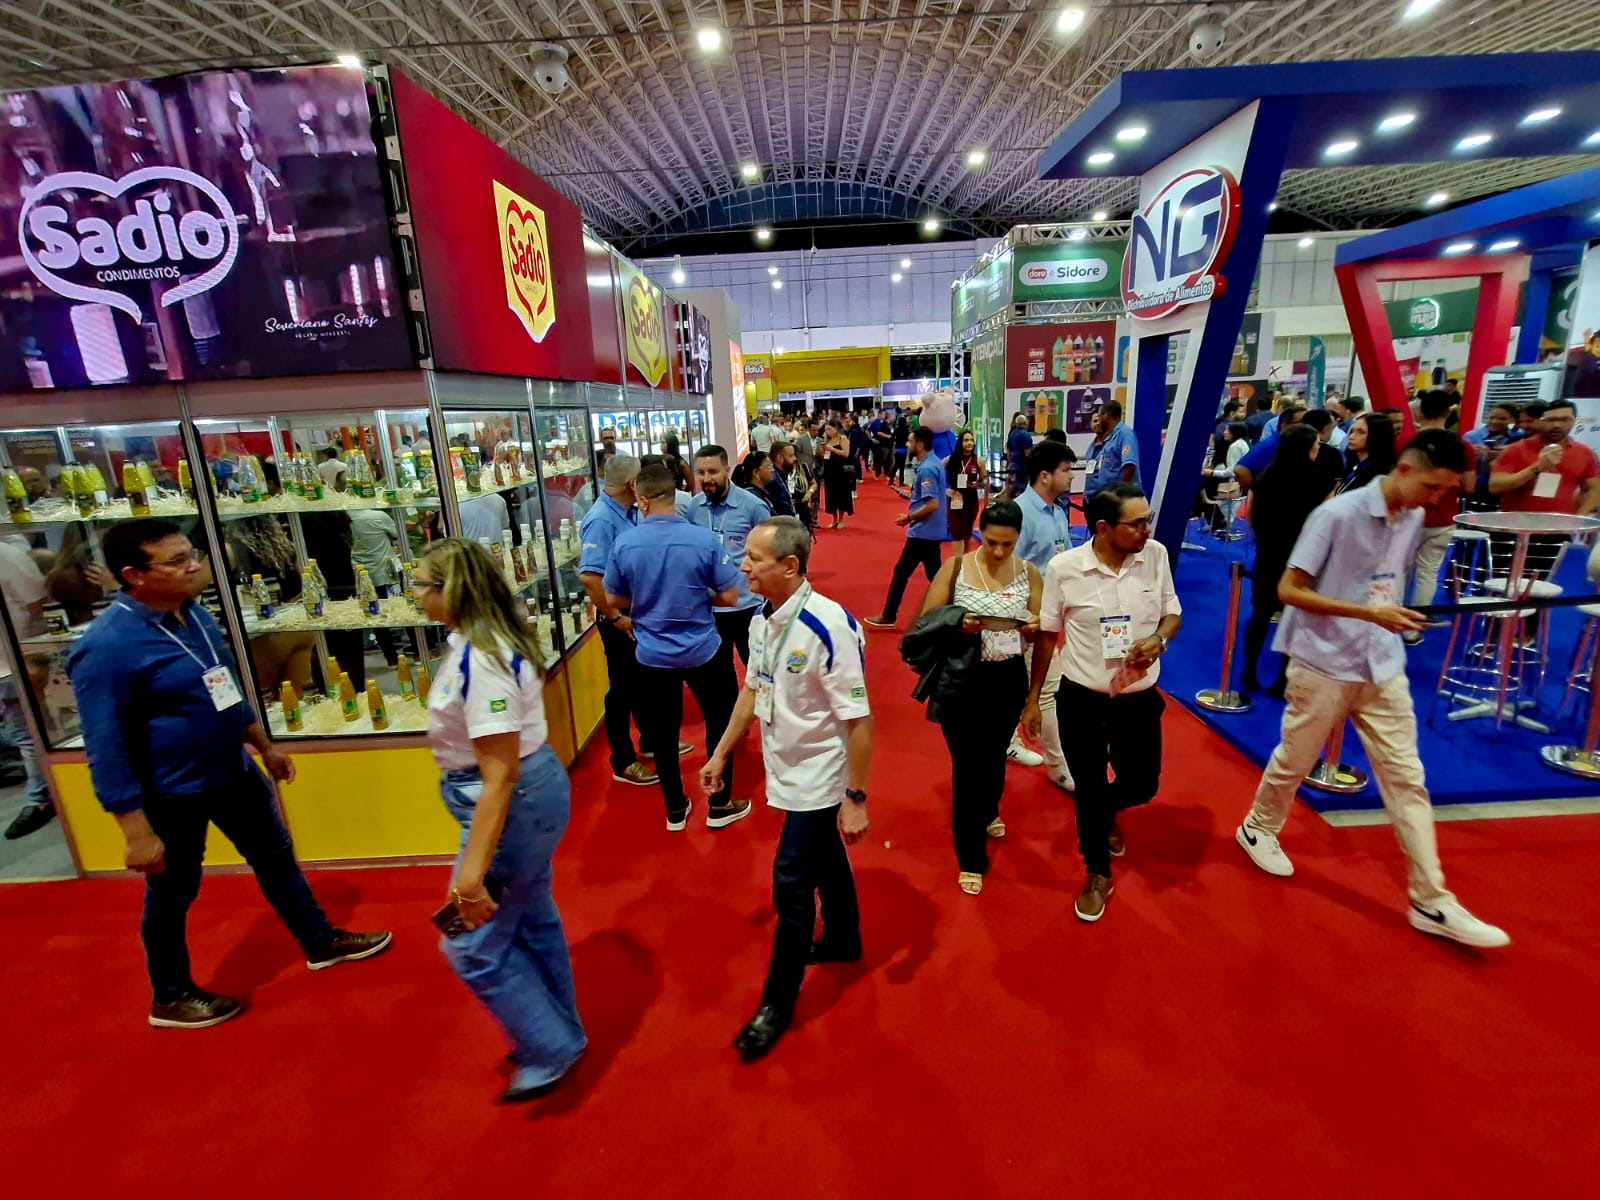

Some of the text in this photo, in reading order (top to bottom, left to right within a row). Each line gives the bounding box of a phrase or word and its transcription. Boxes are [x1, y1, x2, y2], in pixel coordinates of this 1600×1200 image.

[30, 199, 225, 269] Sadio
[1129, 174, 1223, 290] NG
[97, 266, 181, 283] CONDIMENTOS
[509, 223, 545, 286] Sadio
[1057, 265, 1100, 278] Sidore
[1127, 280, 1212, 311] Distribuidora de Alimentos
[631, 295, 659, 344] Sadio
[972, 333, 1004, 363] ATENÇÃO
